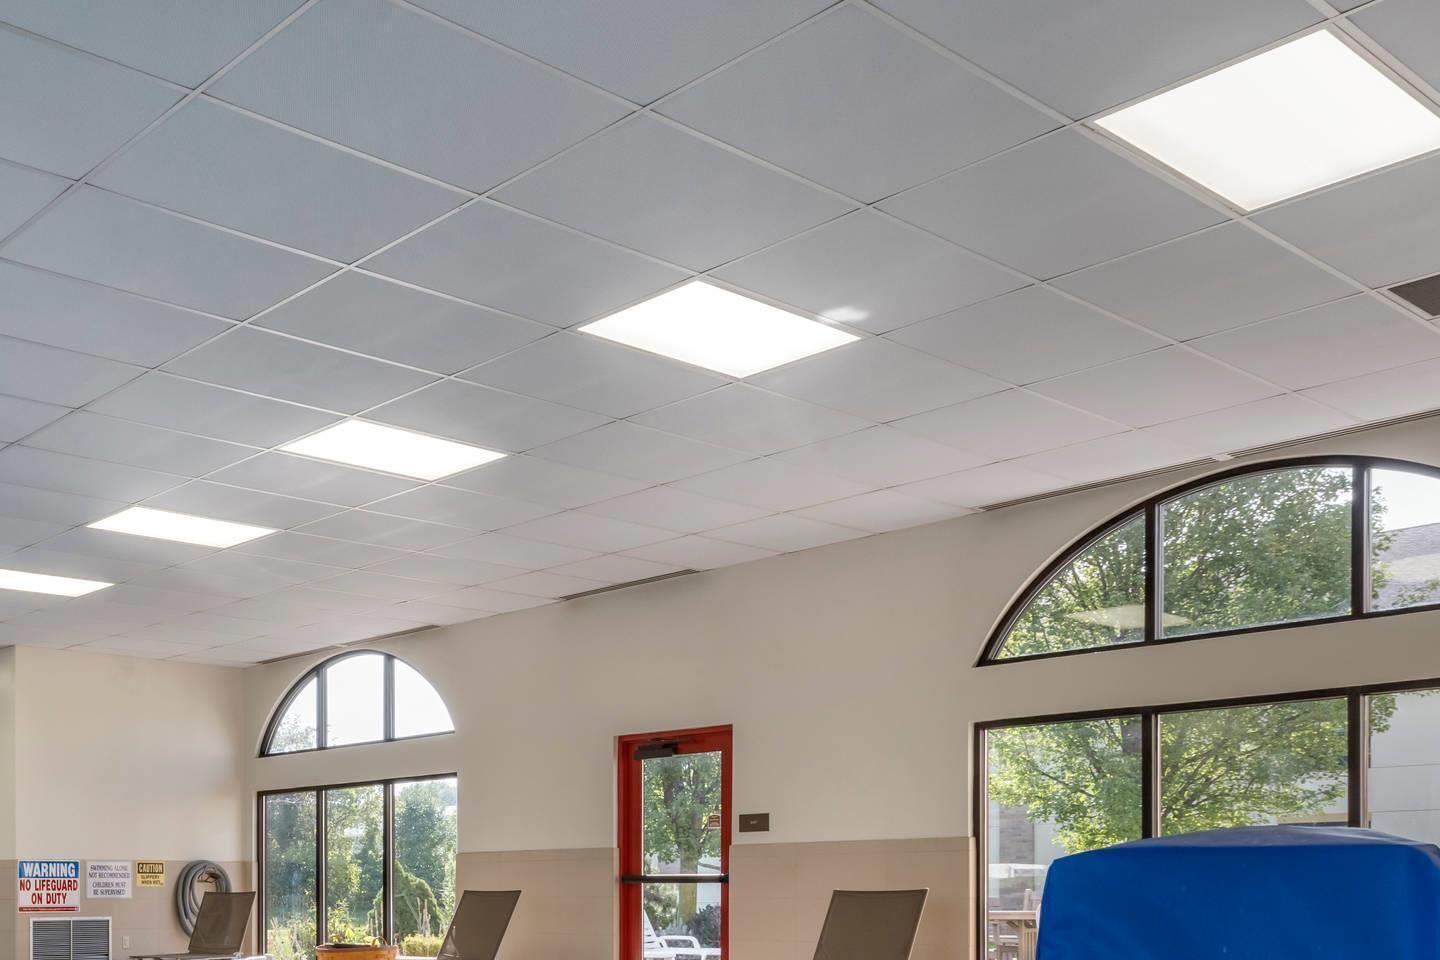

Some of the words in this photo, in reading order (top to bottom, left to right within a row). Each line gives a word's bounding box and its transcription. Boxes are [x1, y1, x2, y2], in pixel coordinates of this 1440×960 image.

[23, 862, 76, 878] WARNING
[138, 863, 163, 873] CAUTION
[19, 879, 31, 891] NO
[35, 879, 78, 891] LIFEGUARD
[92, 881, 114, 889] CHILDREN
[31, 892, 43, 904] ON
[46, 892, 67, 904] DUTY
